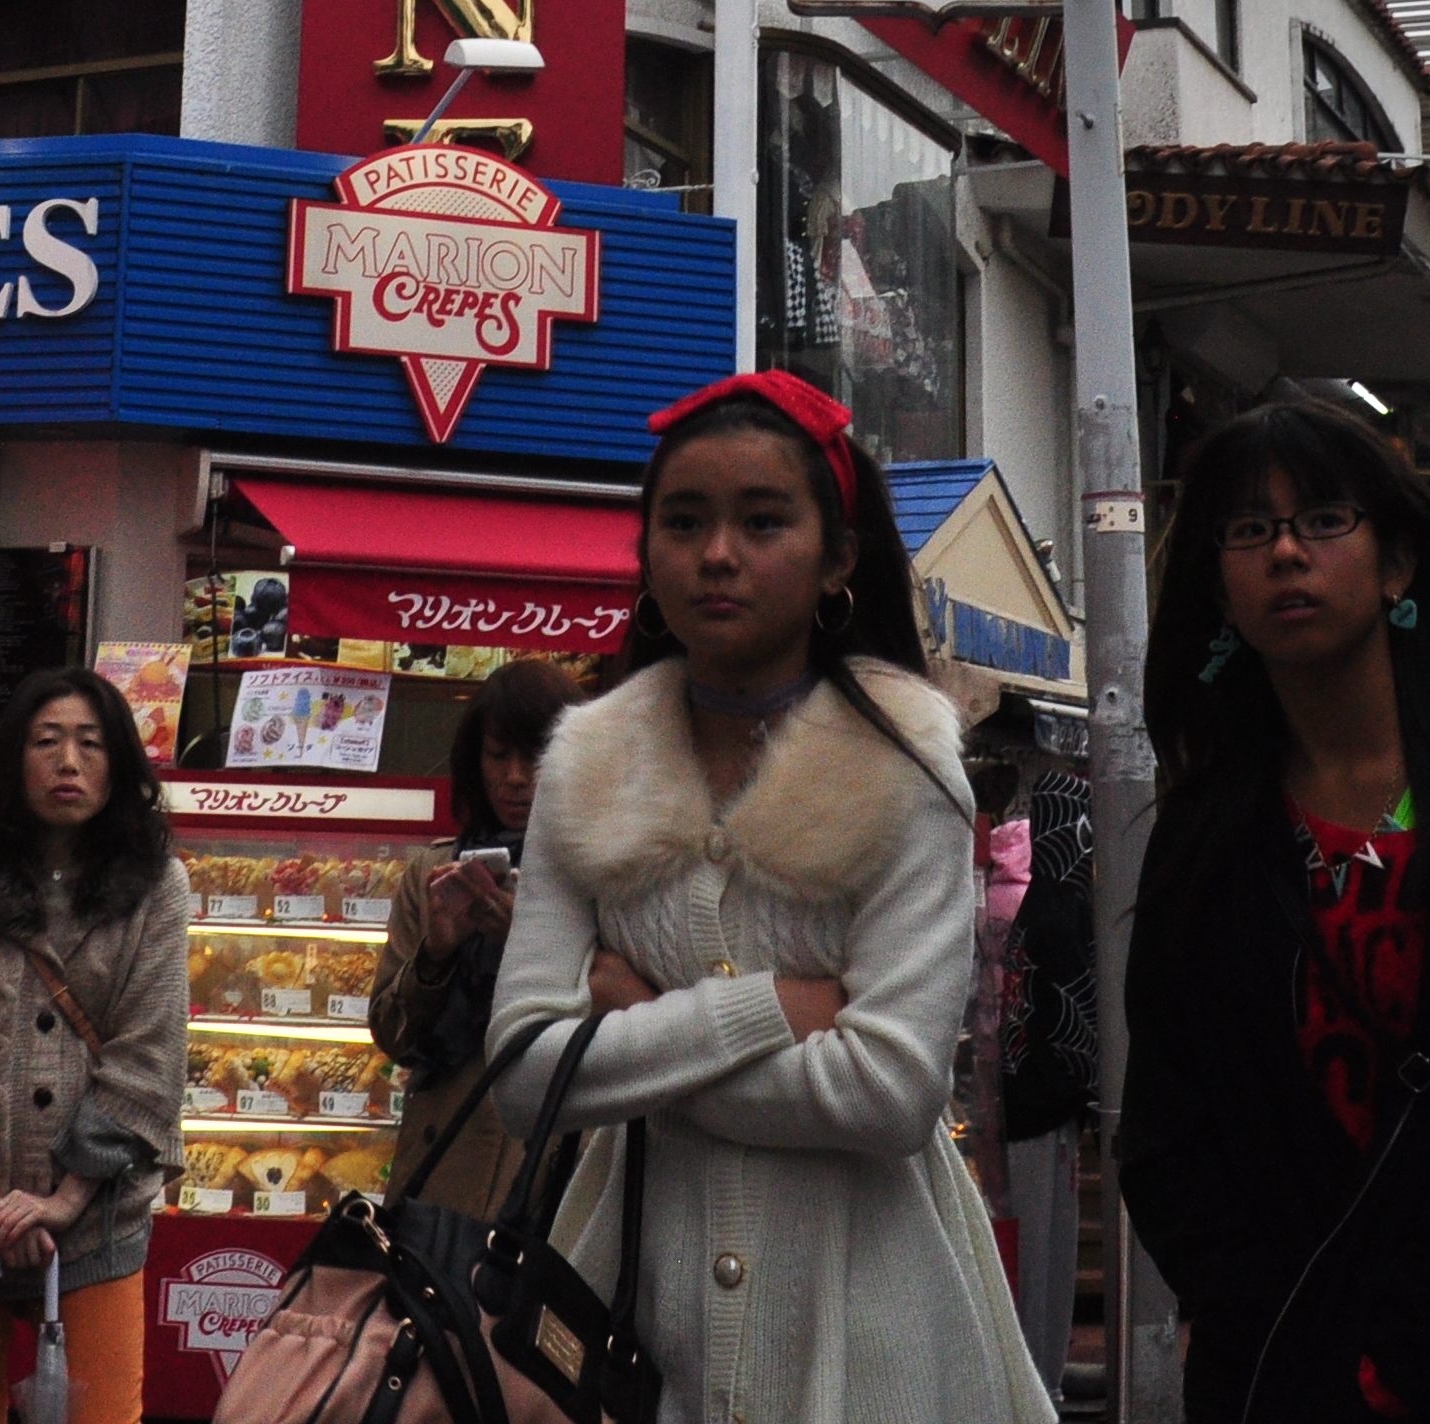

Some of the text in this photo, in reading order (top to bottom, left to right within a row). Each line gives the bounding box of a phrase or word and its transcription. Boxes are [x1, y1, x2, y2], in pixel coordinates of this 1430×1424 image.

[362, 152, 541, 215] PATISSERIE
[1246, 194, 1386, 240] LINE
[321, 222, 578, 298] MARION
[1128, 508, 1138, 523] 9
[386, 588, 631, 640] マリオンクレープ
[188, 787, 349, 815] マリオンクレープ
[196, 1254, 277, 1281] PATISSERIE
[175, 1289, 280, 1319] MARIO
[198, 1310, 264, 1346] CREPE
